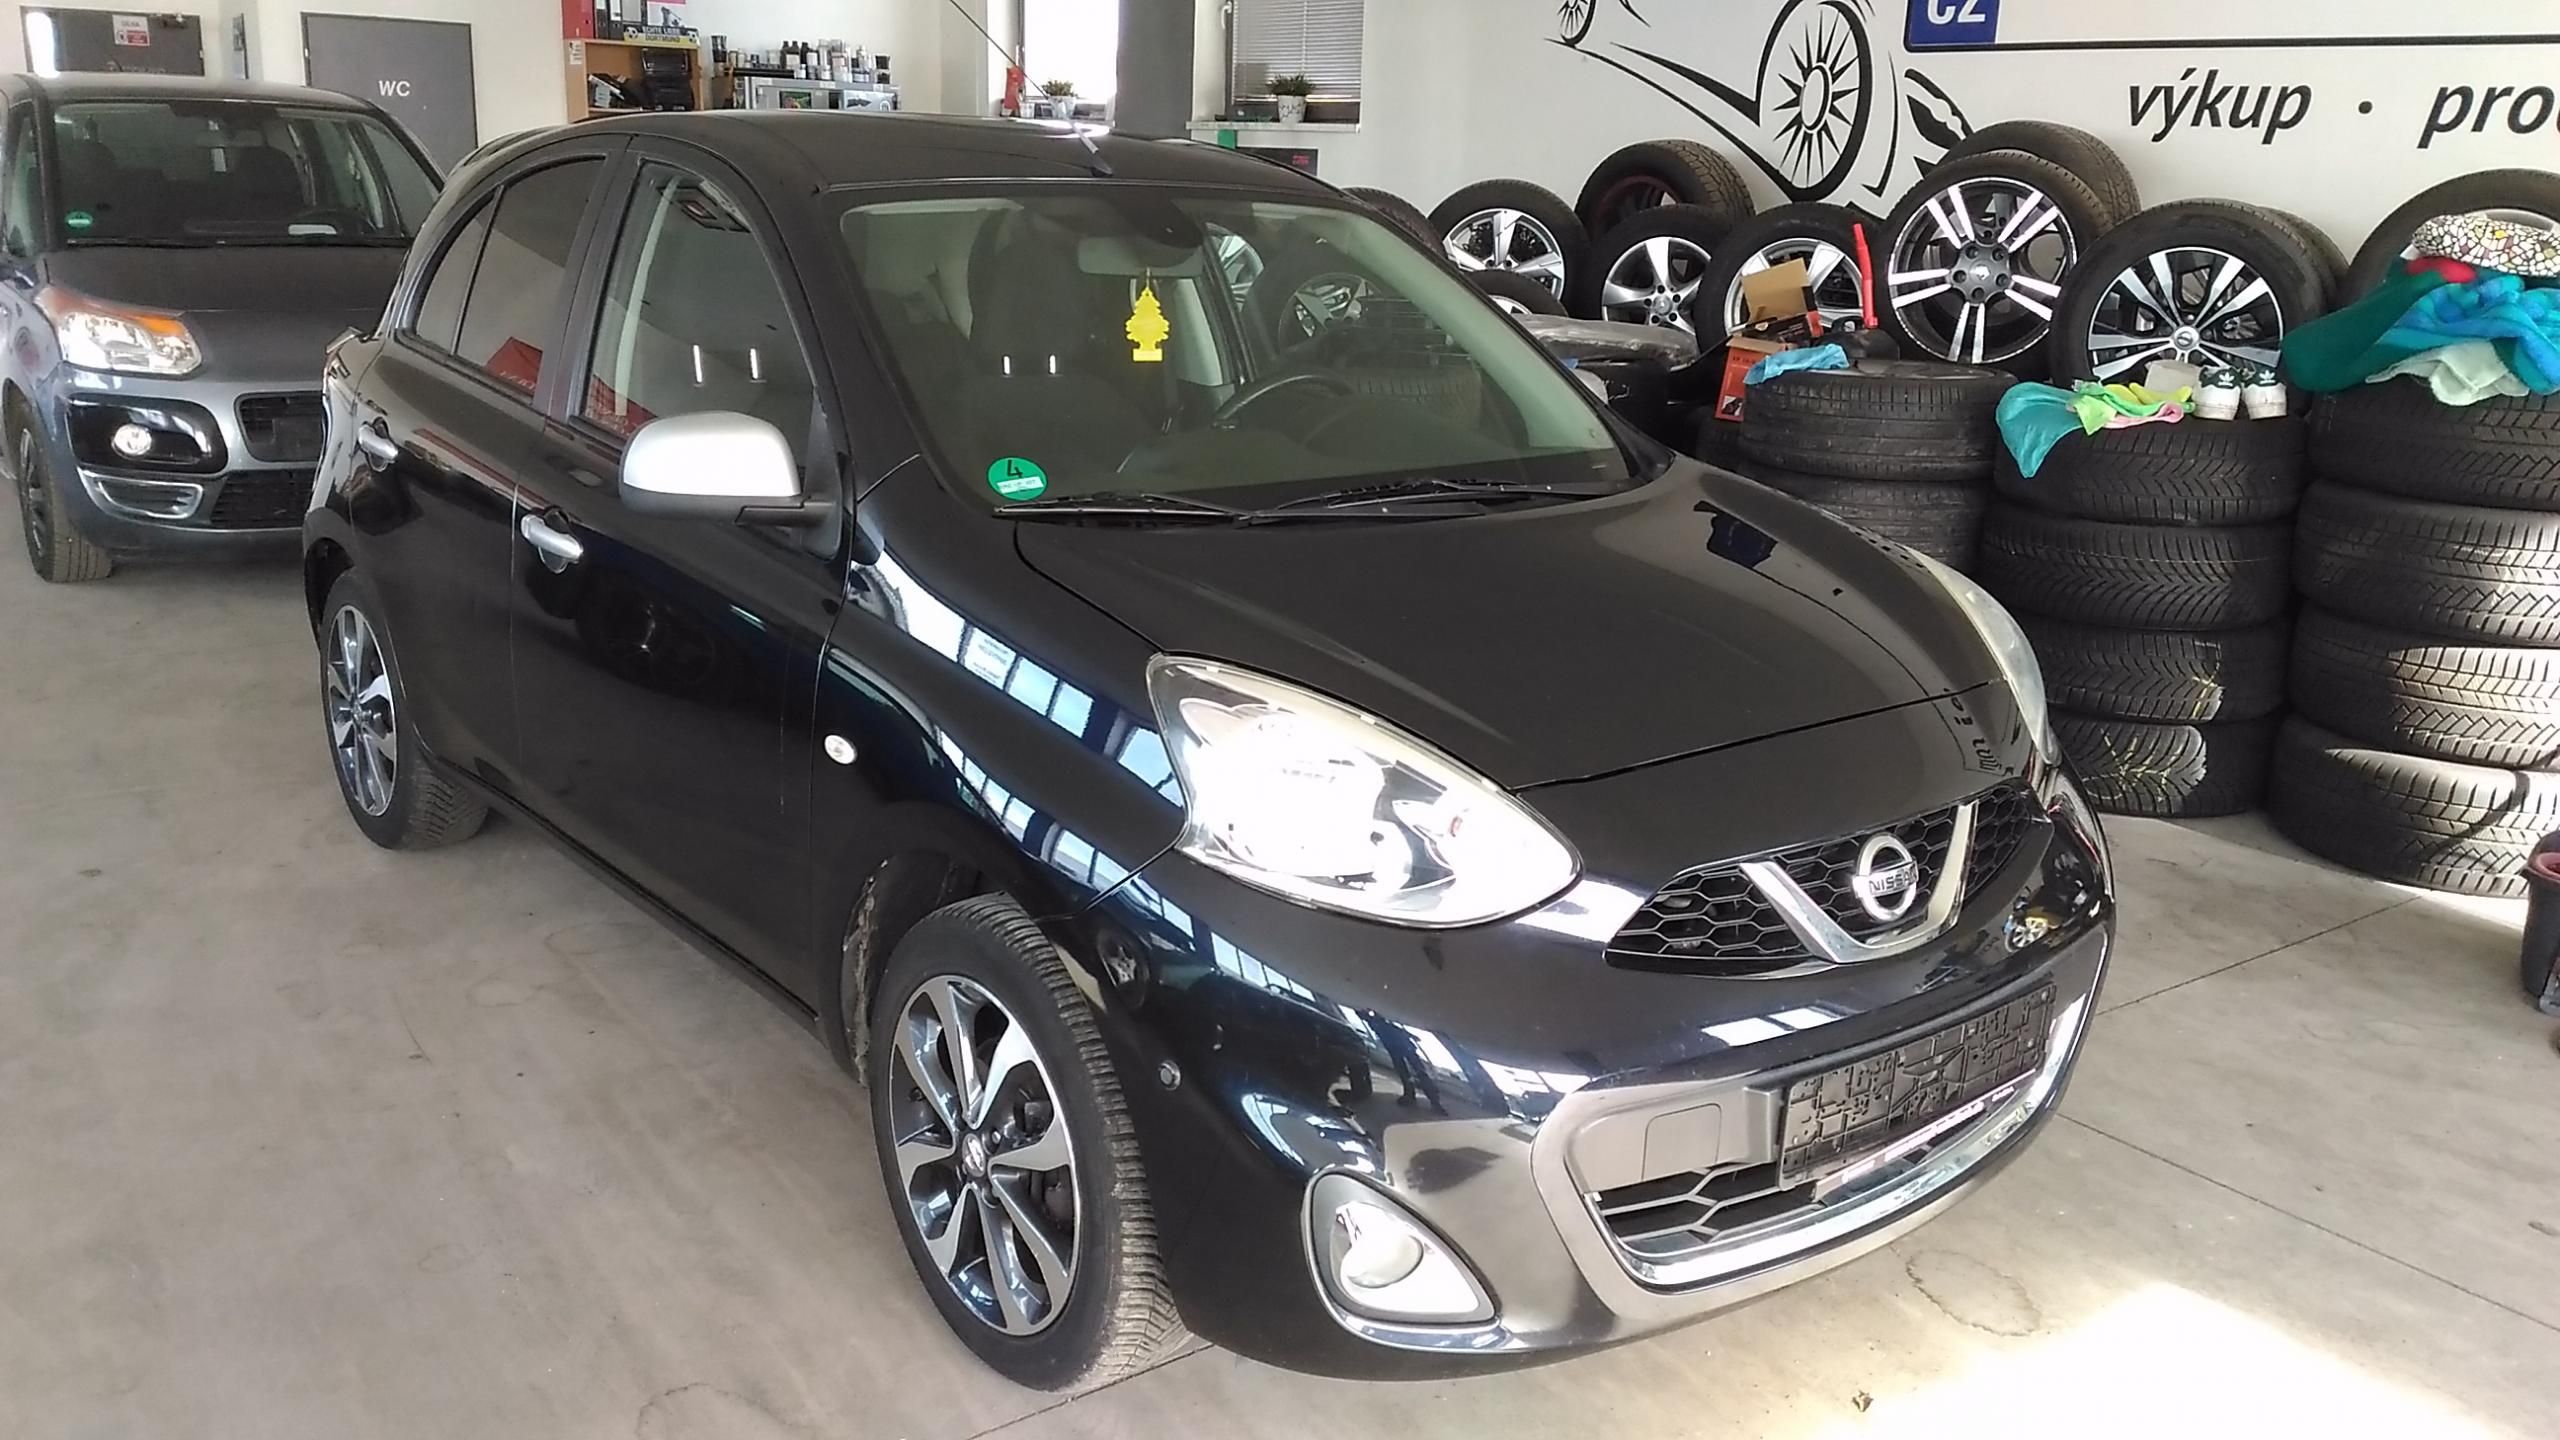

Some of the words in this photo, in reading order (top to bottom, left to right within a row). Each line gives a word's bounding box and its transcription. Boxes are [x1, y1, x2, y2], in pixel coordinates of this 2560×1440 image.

[379, 80, 410, 97] WC
[2129, 67, 2312, 145] výkup
[2416, 85, 2560, 150] pro
[1006, 459, 1024, 479] 4
[1868, 863, 1918, 891] NISSAN
